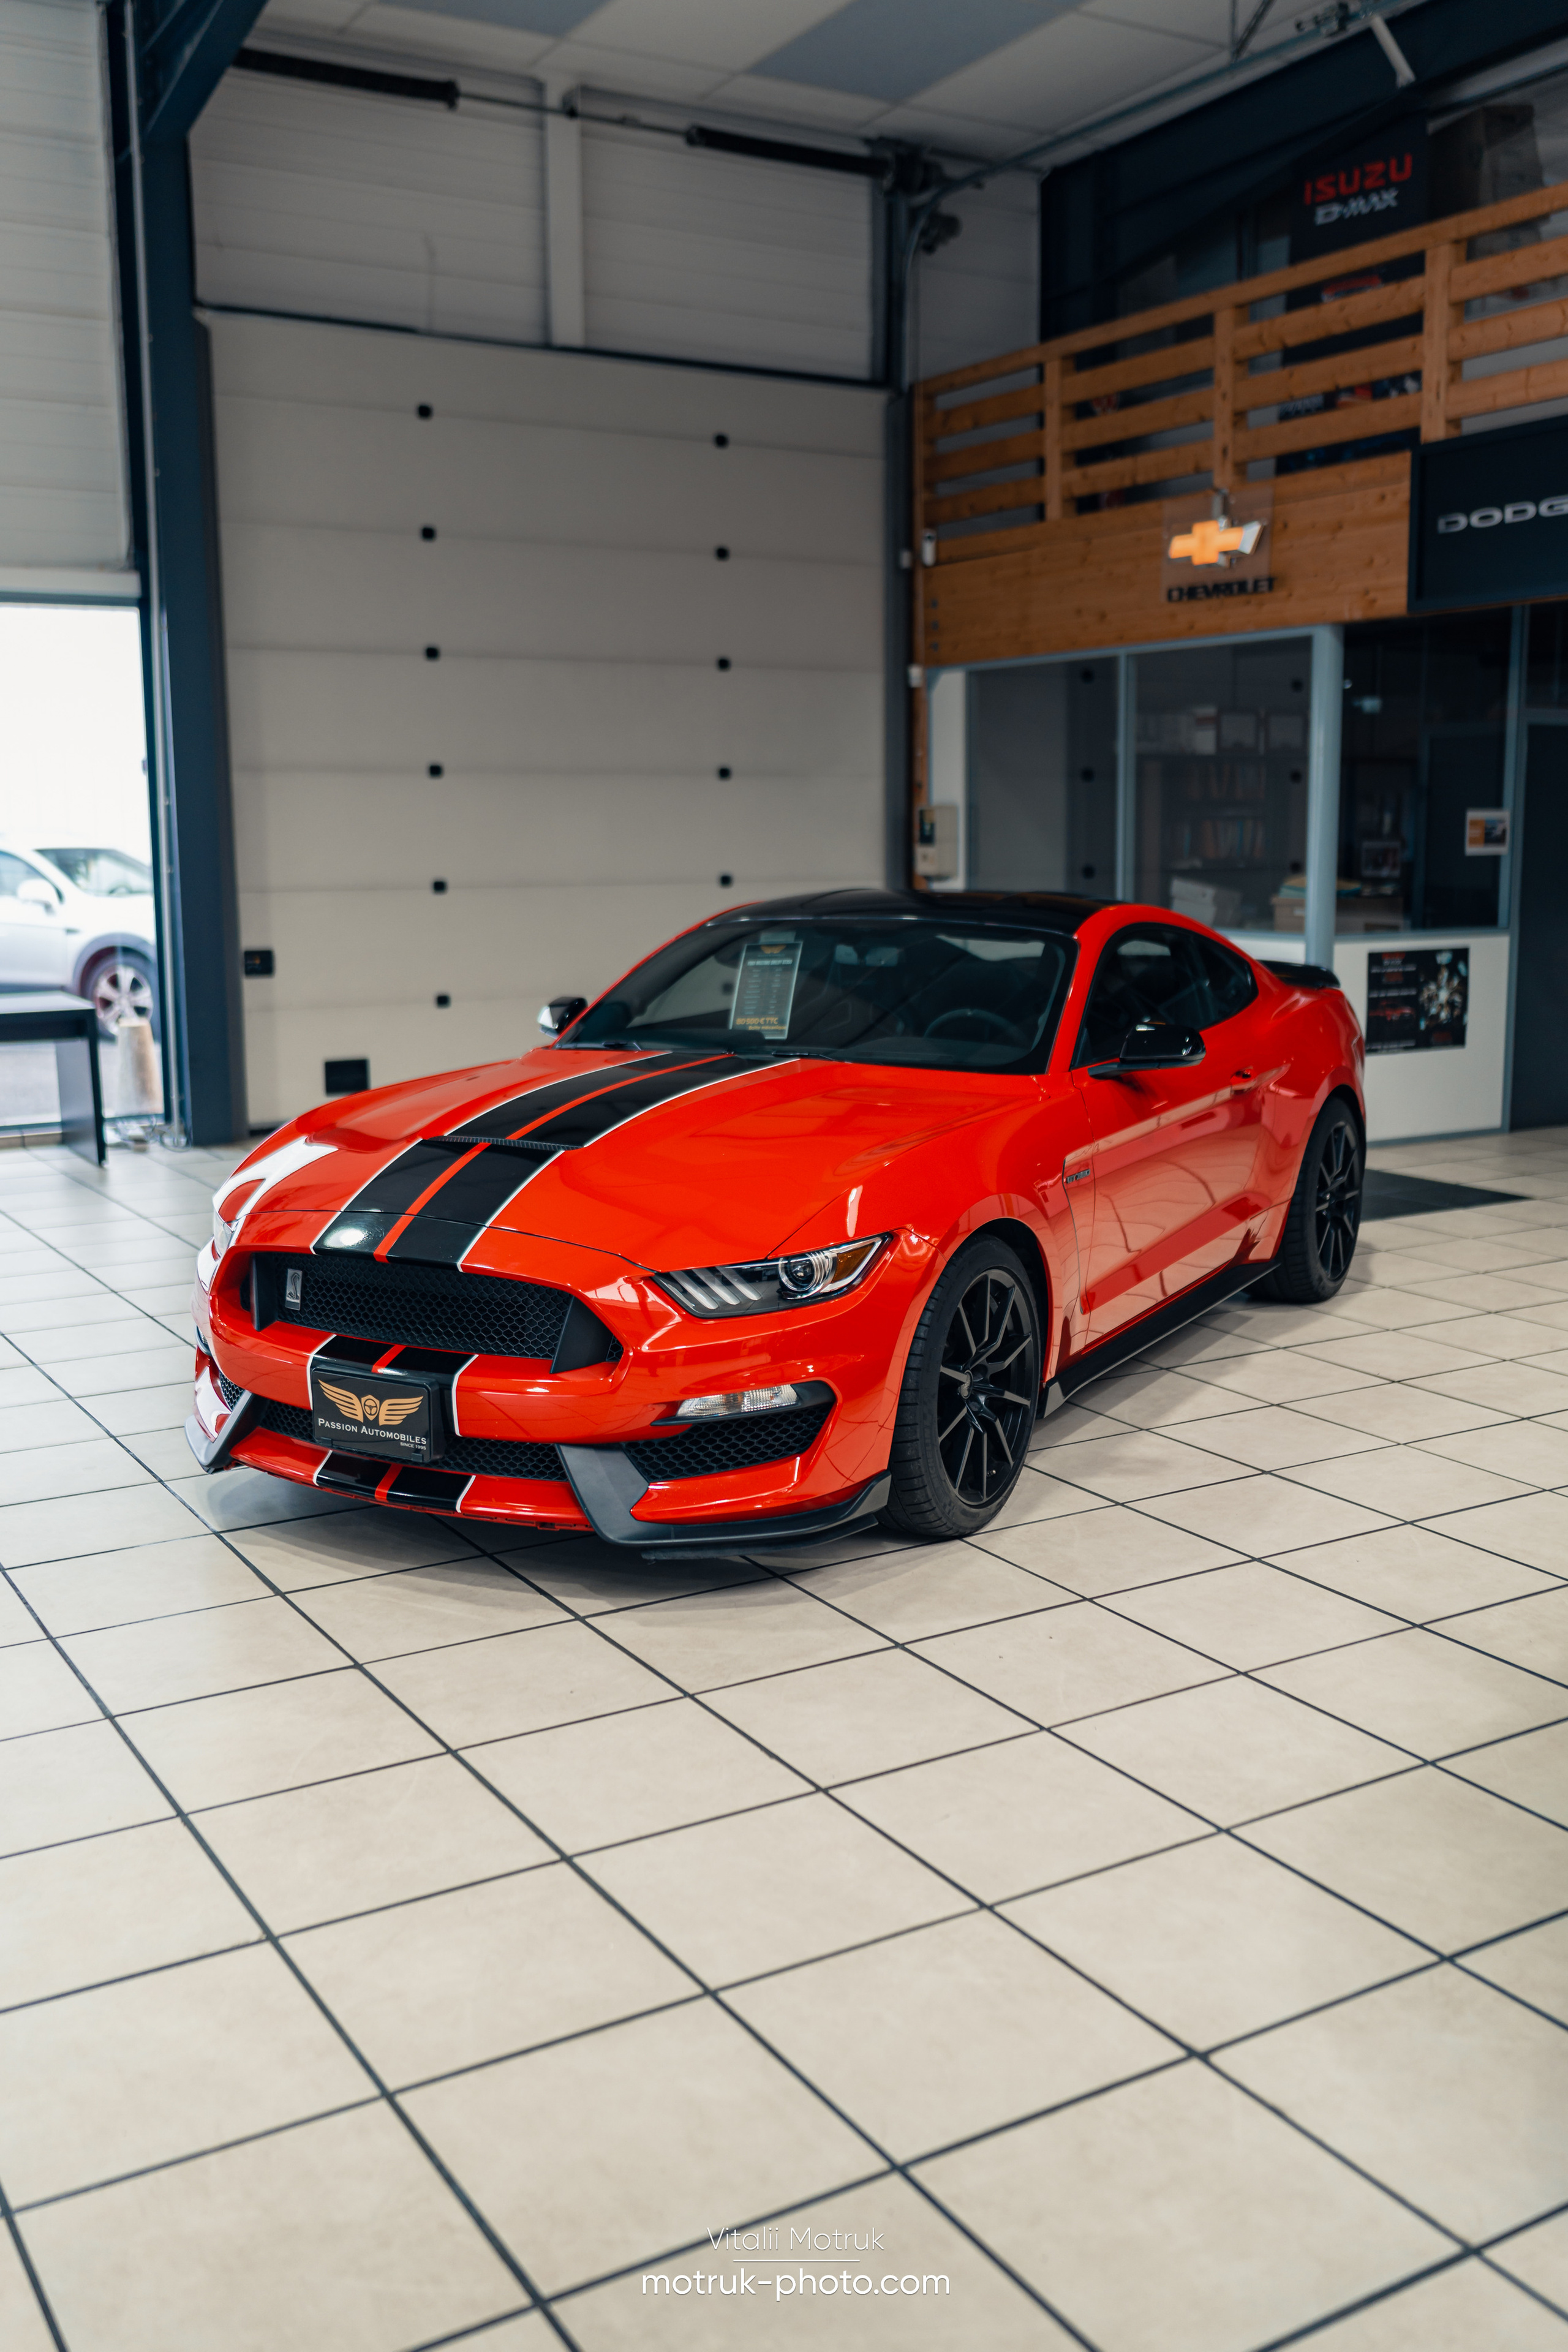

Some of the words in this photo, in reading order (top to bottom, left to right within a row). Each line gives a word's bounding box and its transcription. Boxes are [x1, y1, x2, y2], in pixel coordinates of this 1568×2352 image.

[1303, 153, 1412, 205] ISUZU
[1167, 576, 1275, 603] CHEVROLET
[318, 1418, 358, 1433] PASSION
[361, 1426, 427, 1444] AUTOMOBILES
